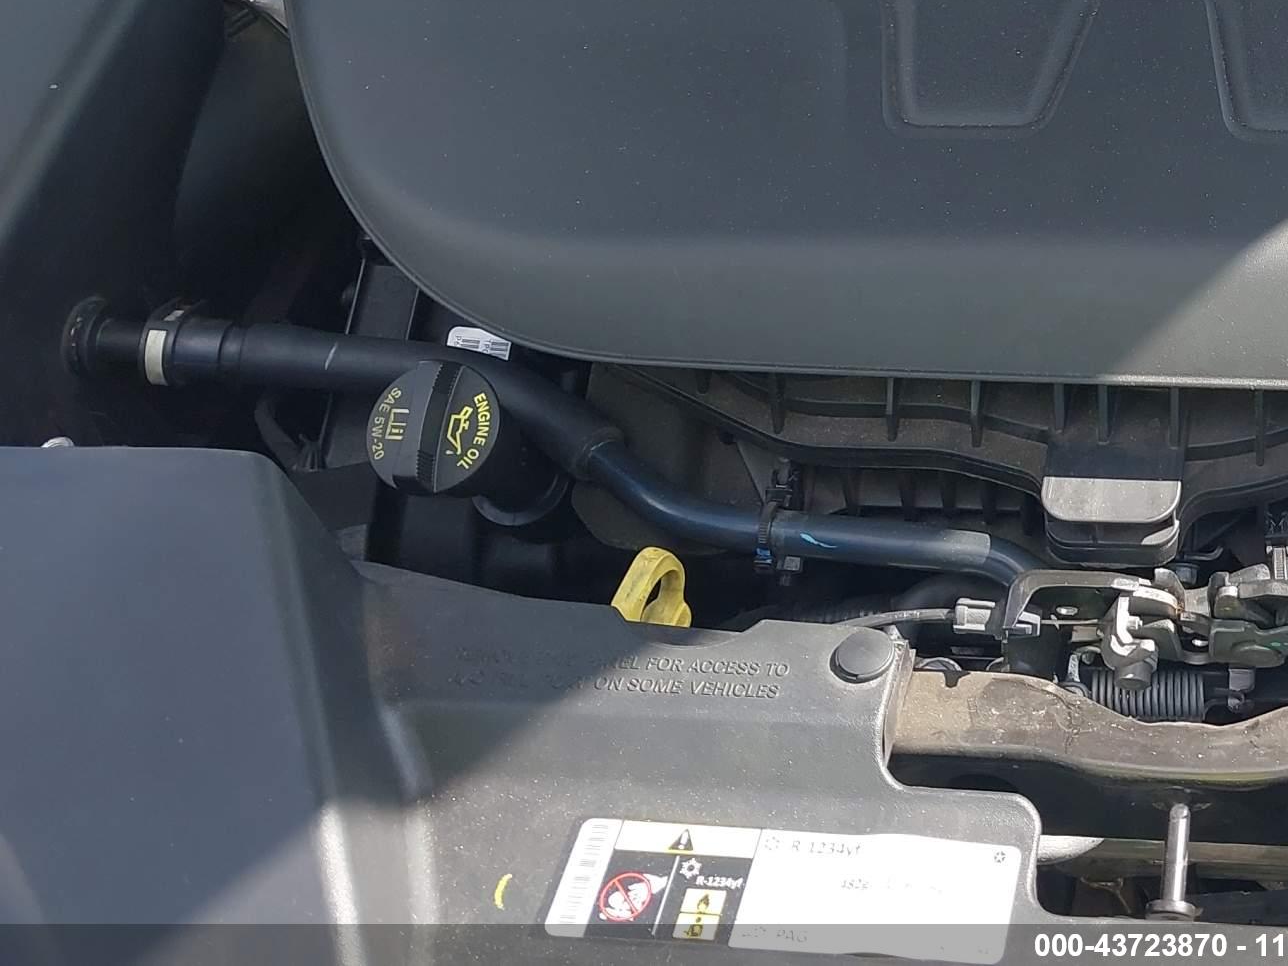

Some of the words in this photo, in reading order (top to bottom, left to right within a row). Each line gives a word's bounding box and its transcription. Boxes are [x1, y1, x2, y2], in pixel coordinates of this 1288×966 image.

[379, 386, 402, 413] SAE
[473, 392, 491, 446] ENGINE
[371, 416, 385, 460] 5W-20
[456, 448, 480, 470] OIL
[646, 656, 684, 672] FOR
[687, 659, 761, 676] ACCESS
[766, 662, 791, 677] TO
[593, 676, 624, 691] ON
[627, 677, 685, 694] SOME
[690, 681, 782, 699] VEHICLES
